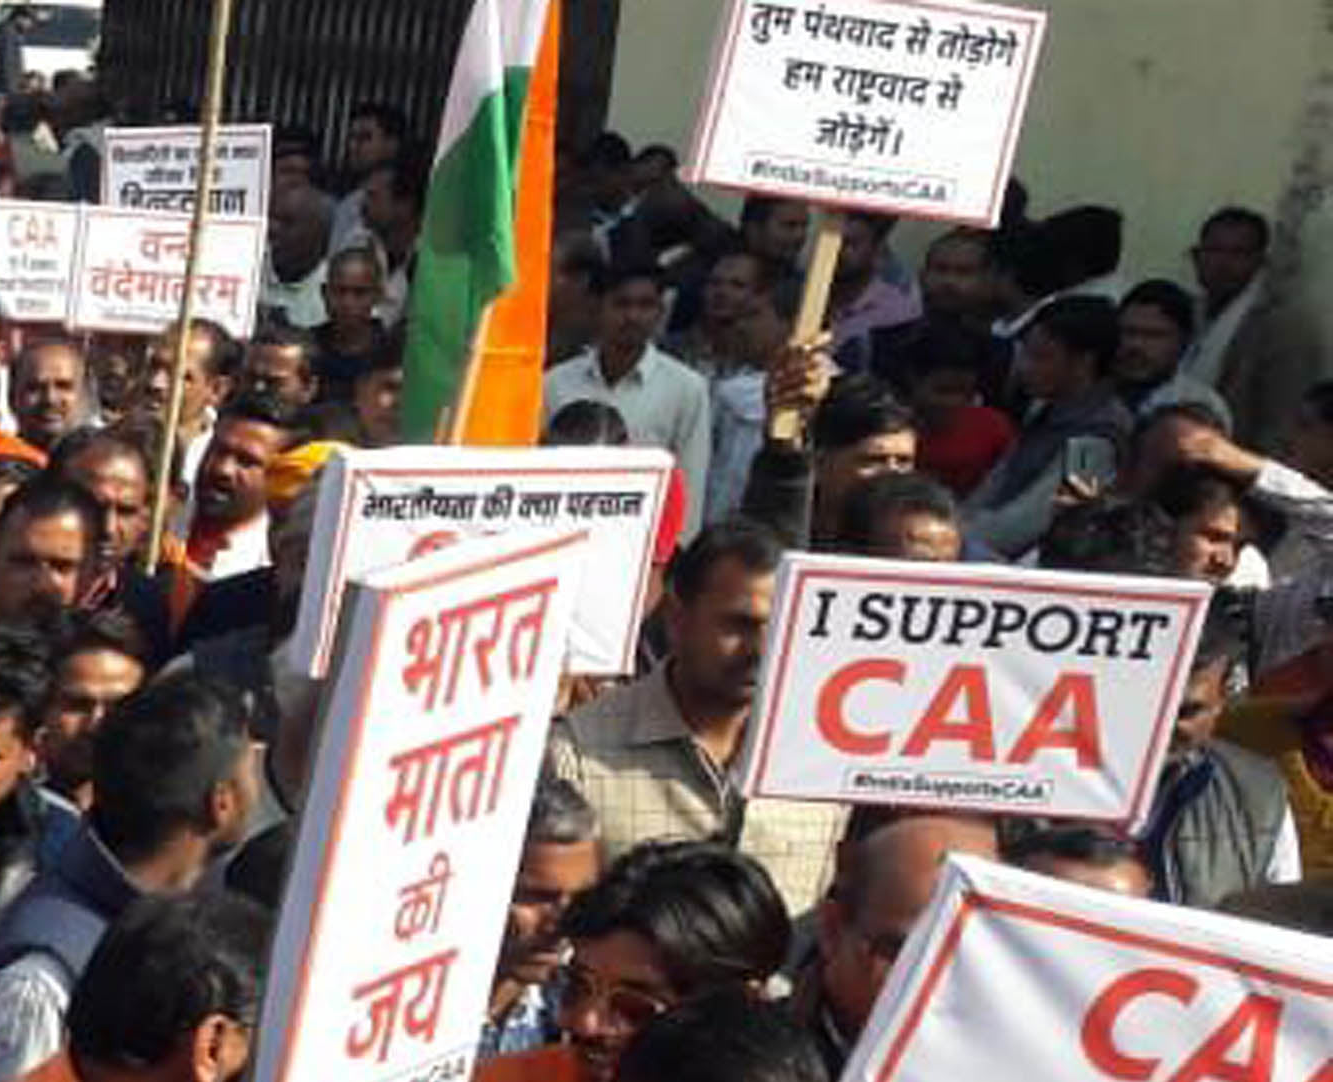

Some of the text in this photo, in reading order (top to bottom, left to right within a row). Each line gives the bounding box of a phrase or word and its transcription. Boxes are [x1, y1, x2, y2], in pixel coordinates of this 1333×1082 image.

[751, 3, 795, 44] तुम
[803, 4, 899, 50] पंथवाद
[906, 16, 932, 54] से
[783, 57, 964, 110] हम राष्ट्रवाद से
[362, 484, 647, 520] भारतीयता की क्या पहचान
[401, 577, 559, 711] भारत
[808, 591, 1169, 660] I SUPPORT
[815, 658, 1104, 770] CAA
[385, 714, 521, 847] माता
[394, 852, 455, 944] की
[346, 949, 459, 1062] जय
